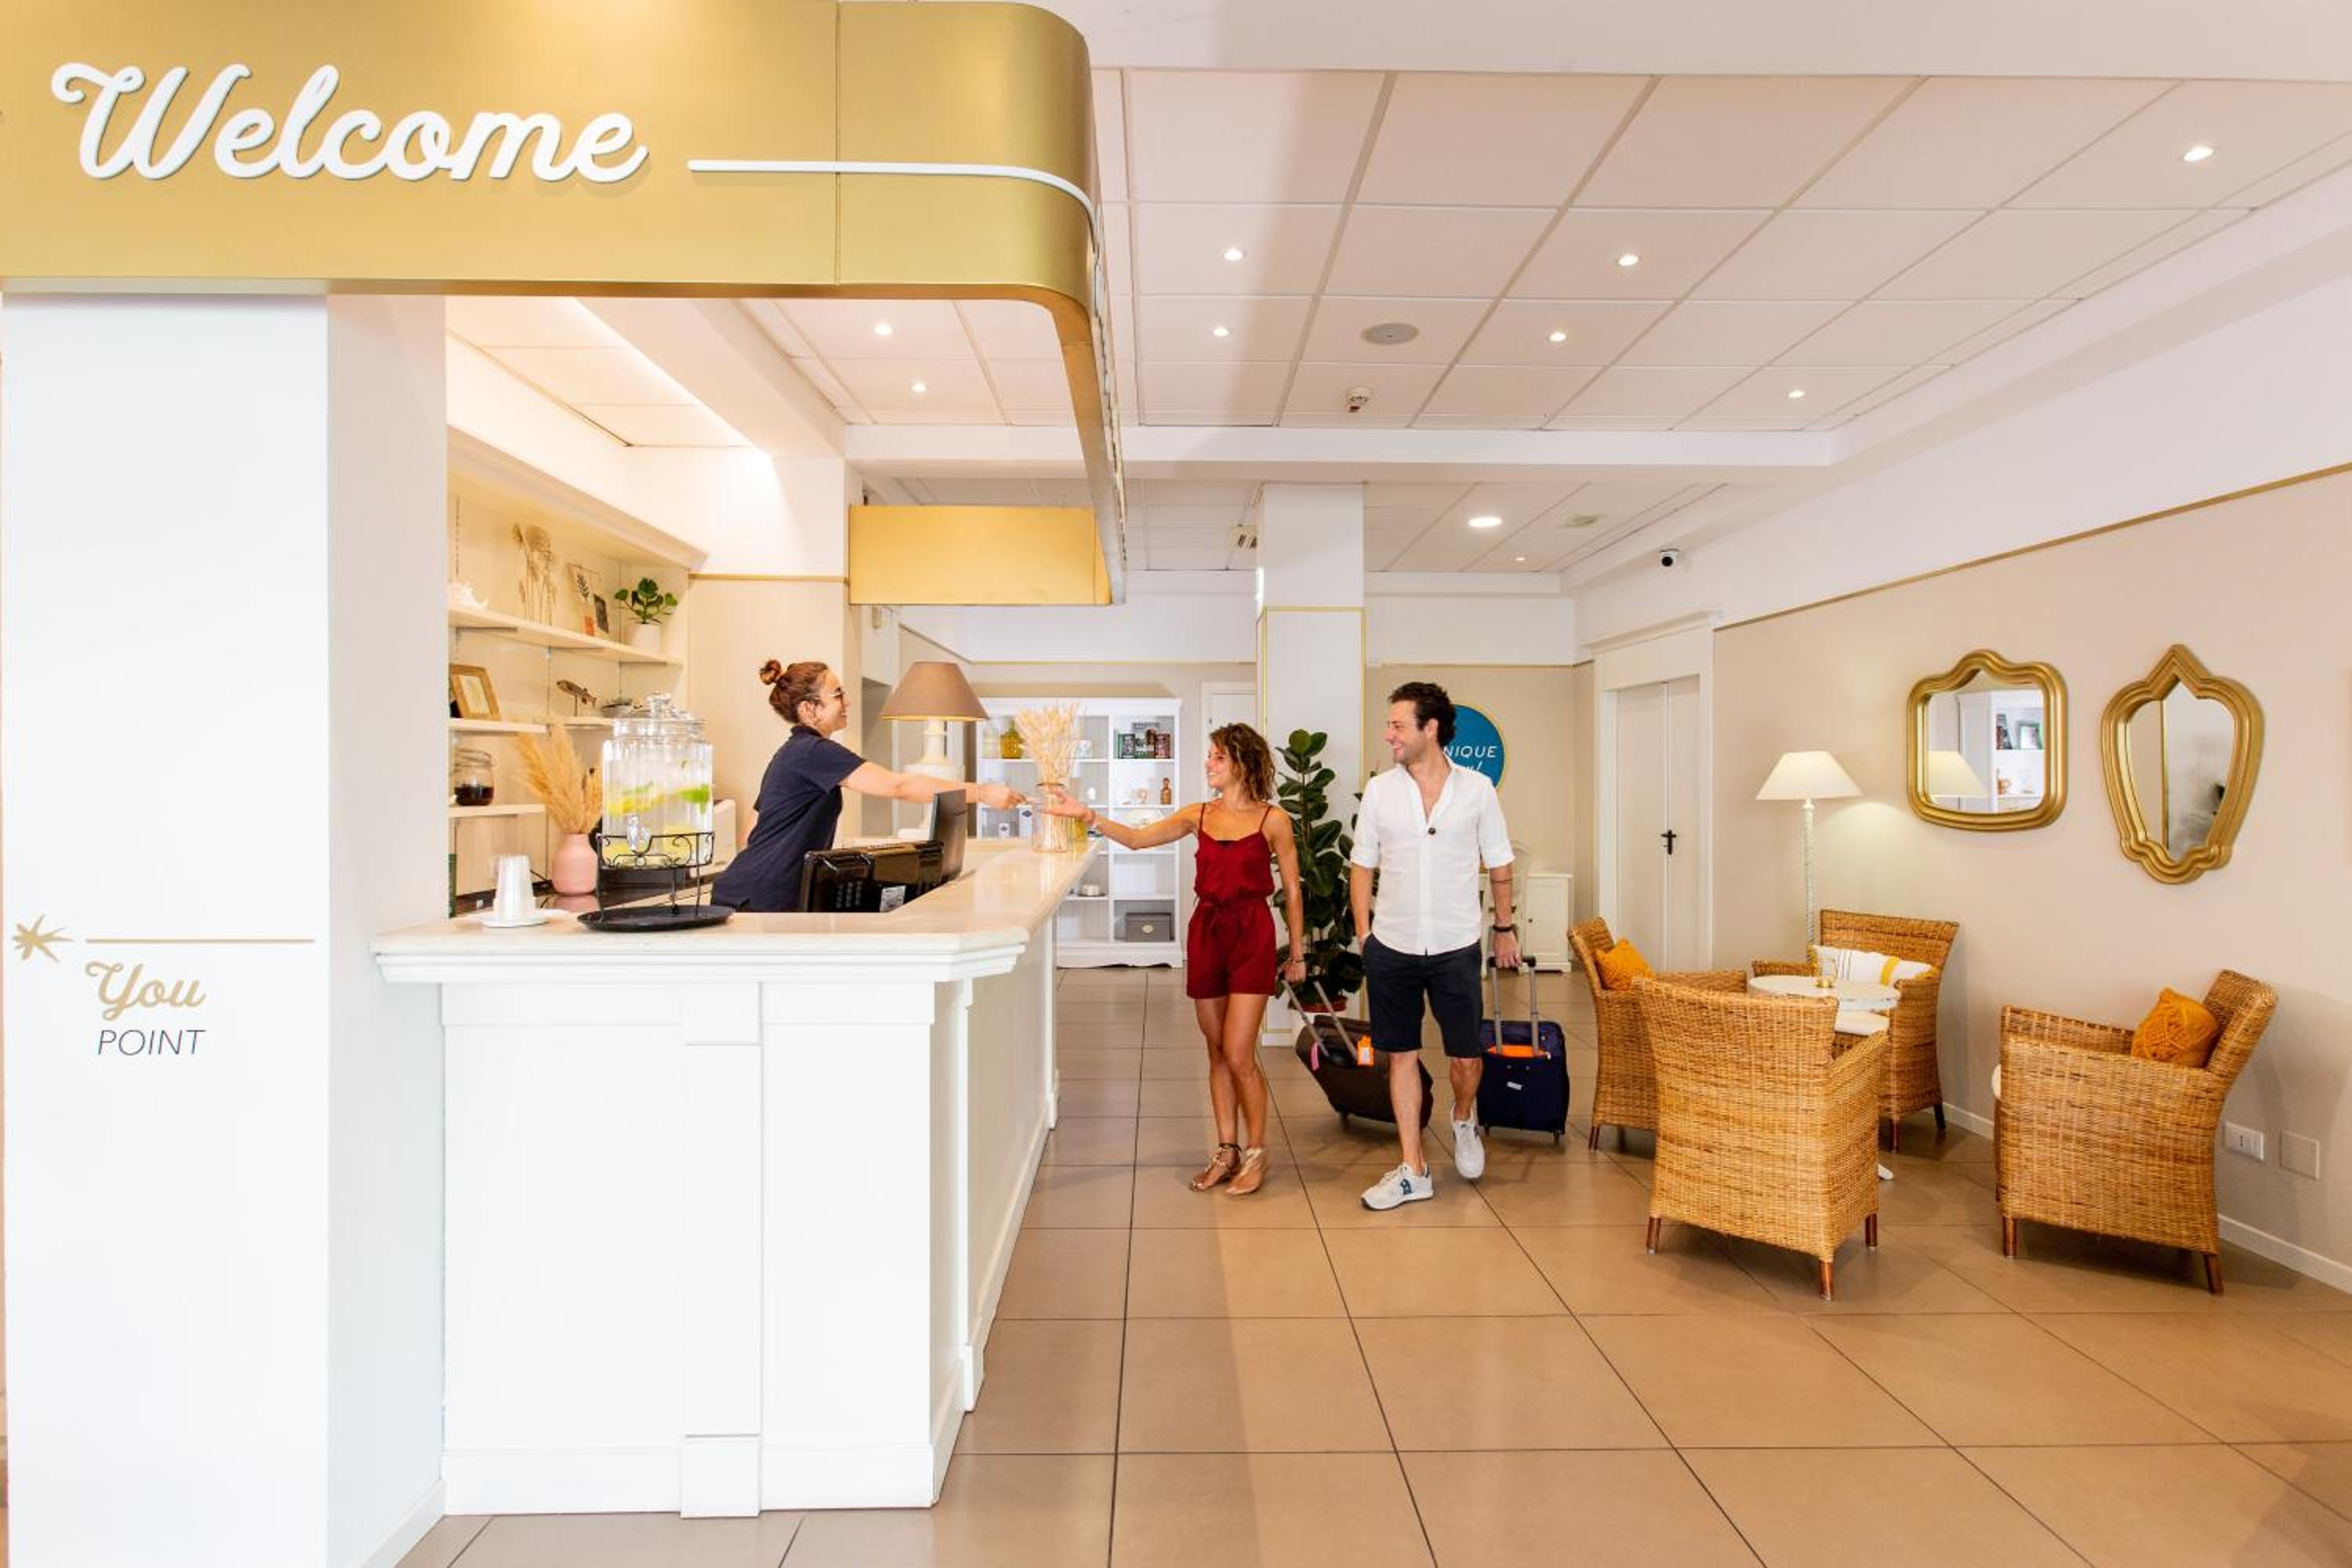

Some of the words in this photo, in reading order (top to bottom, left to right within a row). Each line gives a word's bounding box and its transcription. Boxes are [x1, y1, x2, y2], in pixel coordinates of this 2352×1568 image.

[51, 61, 648, 182] Welcome
[1443, 746, 1497, 759] NIQUE
[85, 960, 207, 1022] You
[97, 1029, 206, 1056] POINT
